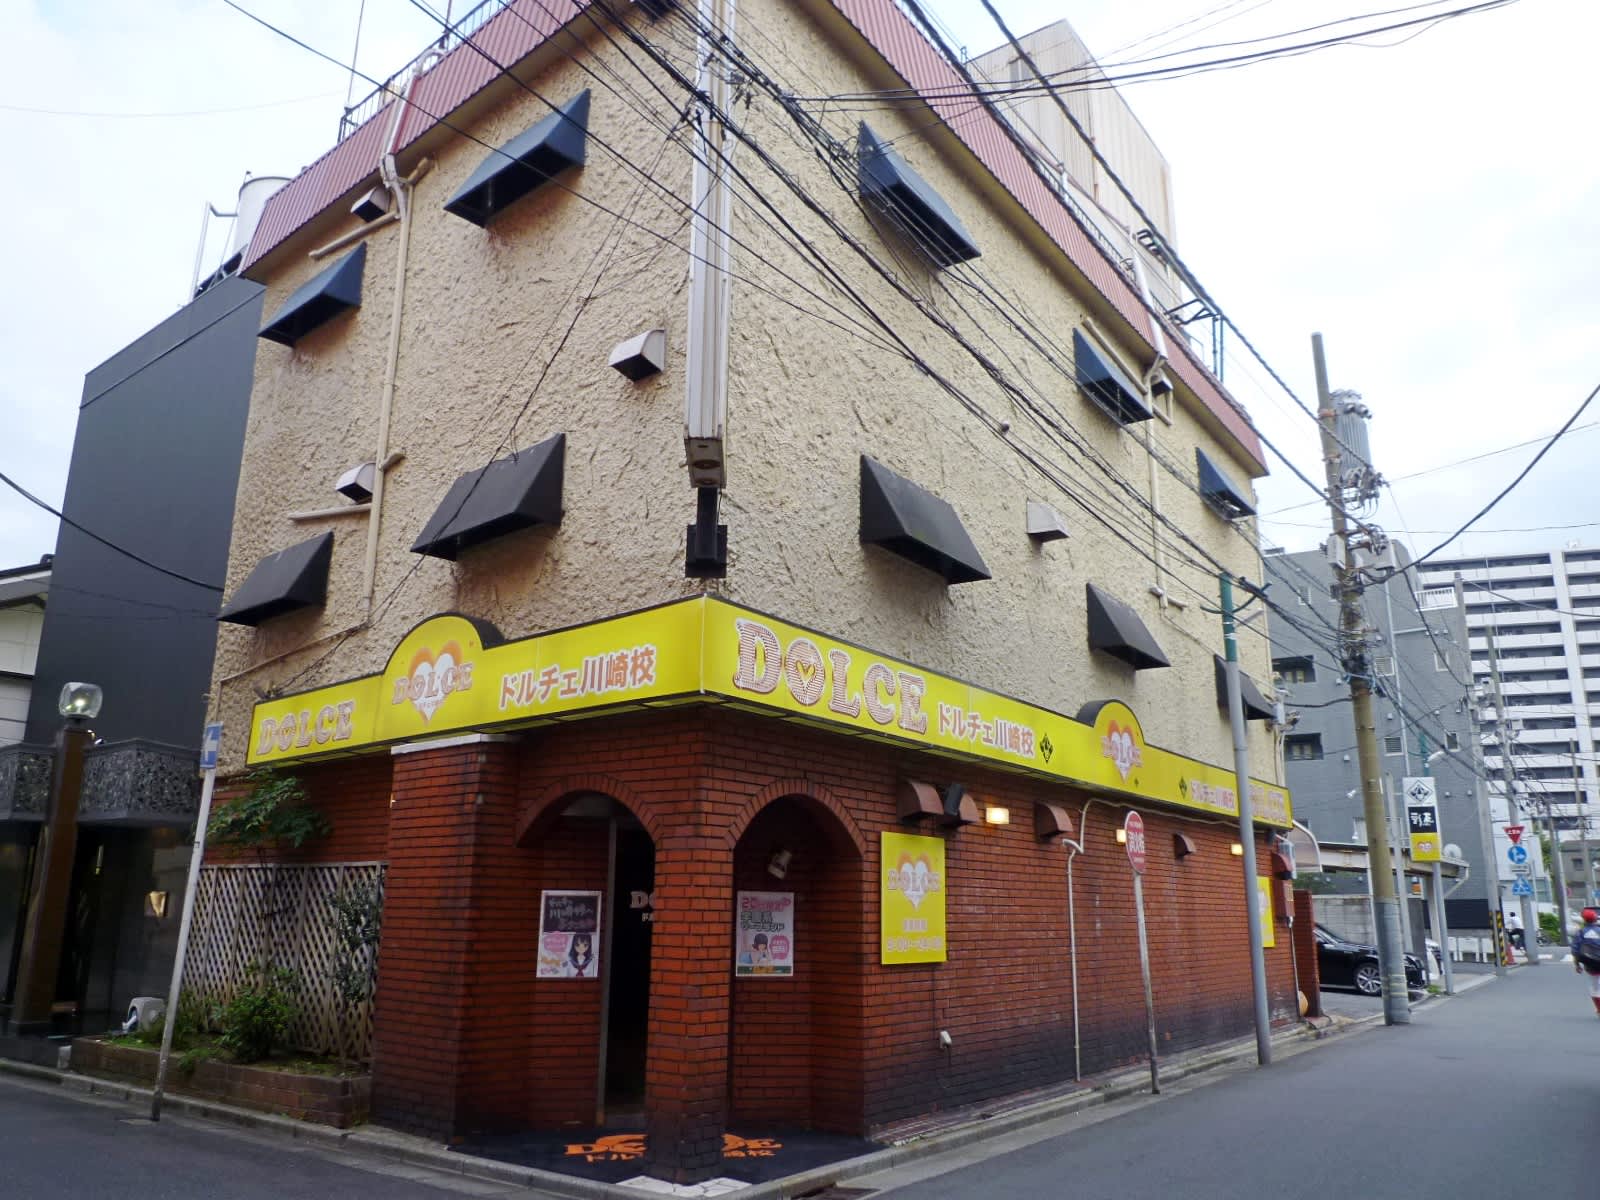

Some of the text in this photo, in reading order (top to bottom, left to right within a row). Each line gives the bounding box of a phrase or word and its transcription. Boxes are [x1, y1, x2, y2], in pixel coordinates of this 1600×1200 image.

[391, 662, 474, 705] DOLCE
[499, 645, 656, 710] ドルチェ川崎校
[733, 617, 928, 735] DOLCE
[256, 700, 356, 755] DOLCE
[938, 703, 1035, 758] ドルチェ川崎校
